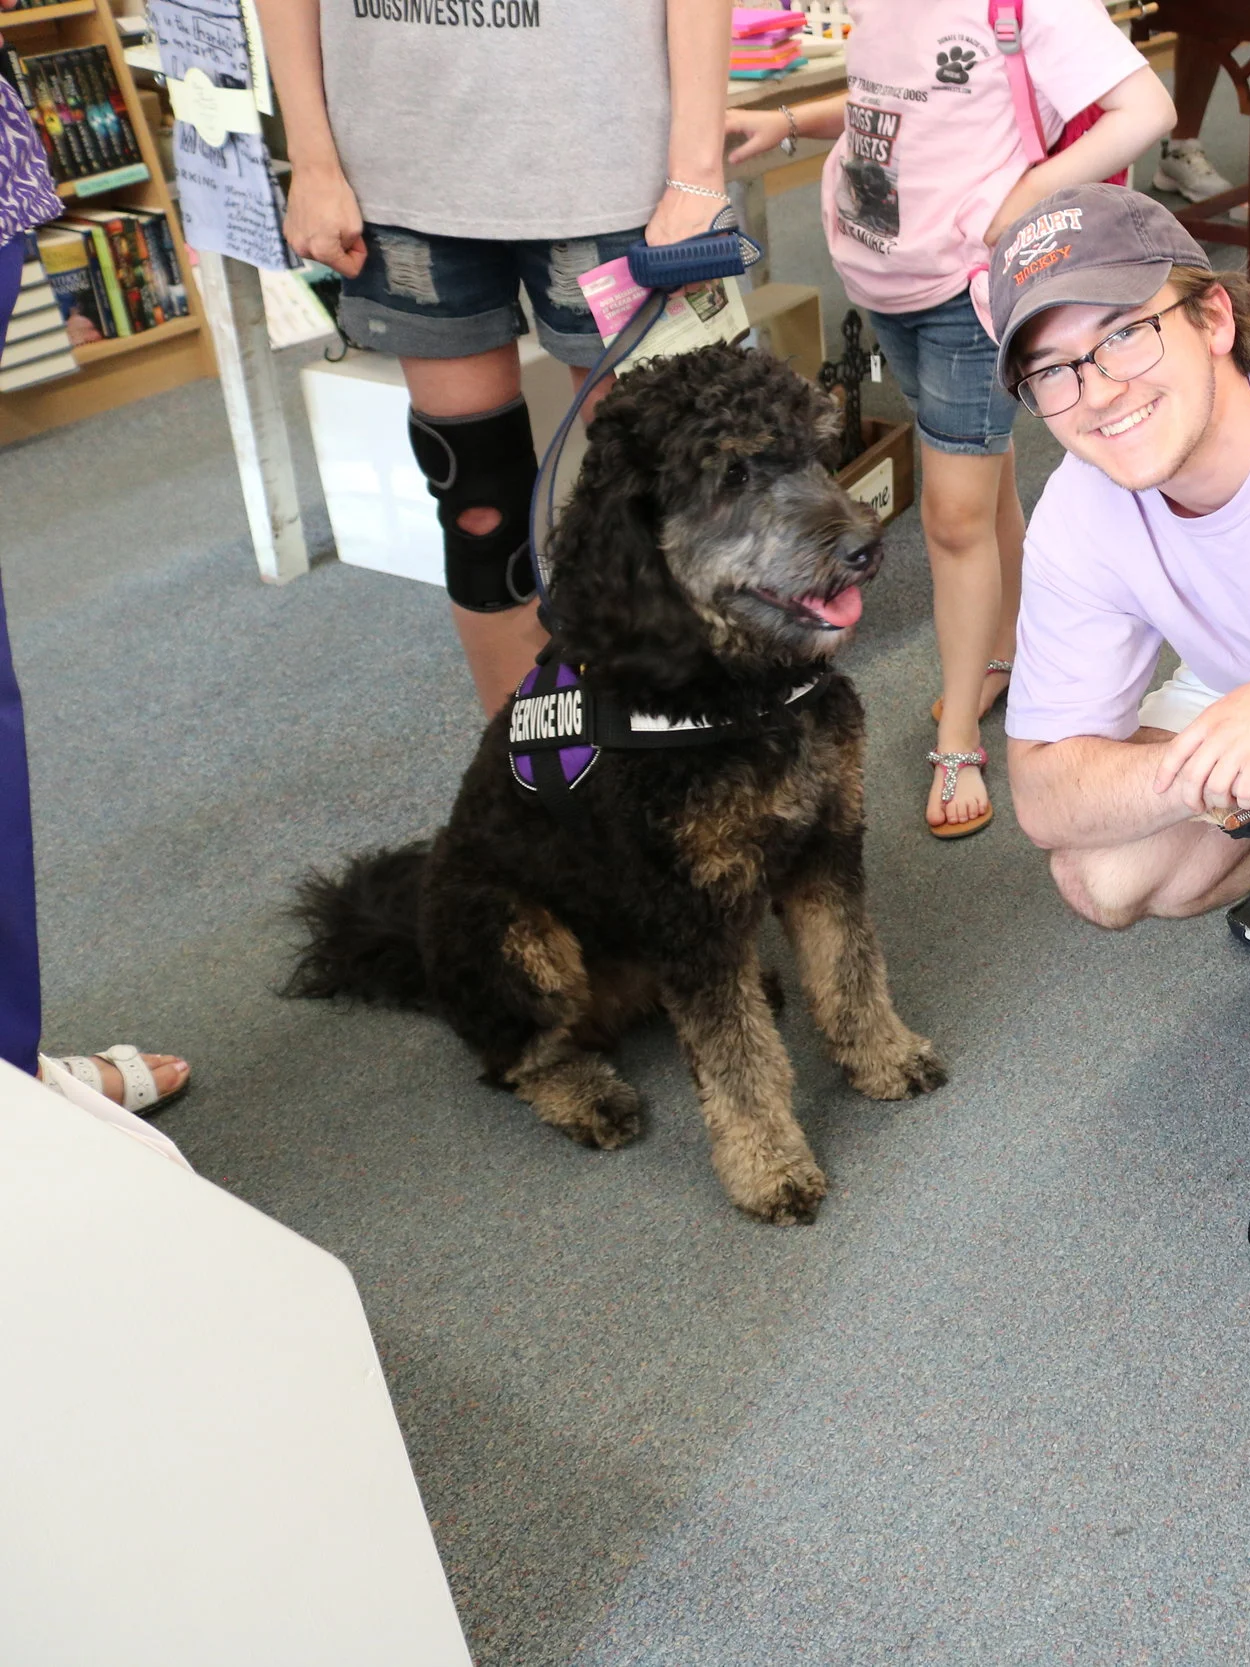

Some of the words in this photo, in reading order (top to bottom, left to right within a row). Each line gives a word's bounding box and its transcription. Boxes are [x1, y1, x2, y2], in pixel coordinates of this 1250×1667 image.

[355, 0, 541, 28] DOGSINVESTS.COM
[903, 88, 928, 102] DOGS
[877, 113, 897, 137] IN
[1003, 207, 1083, 275] HOBART
[1013, 245, 1072, 286] HOCKEY
[509, 694, 556, 743] SERVICE
[556, 689, 583, 737] DOG
